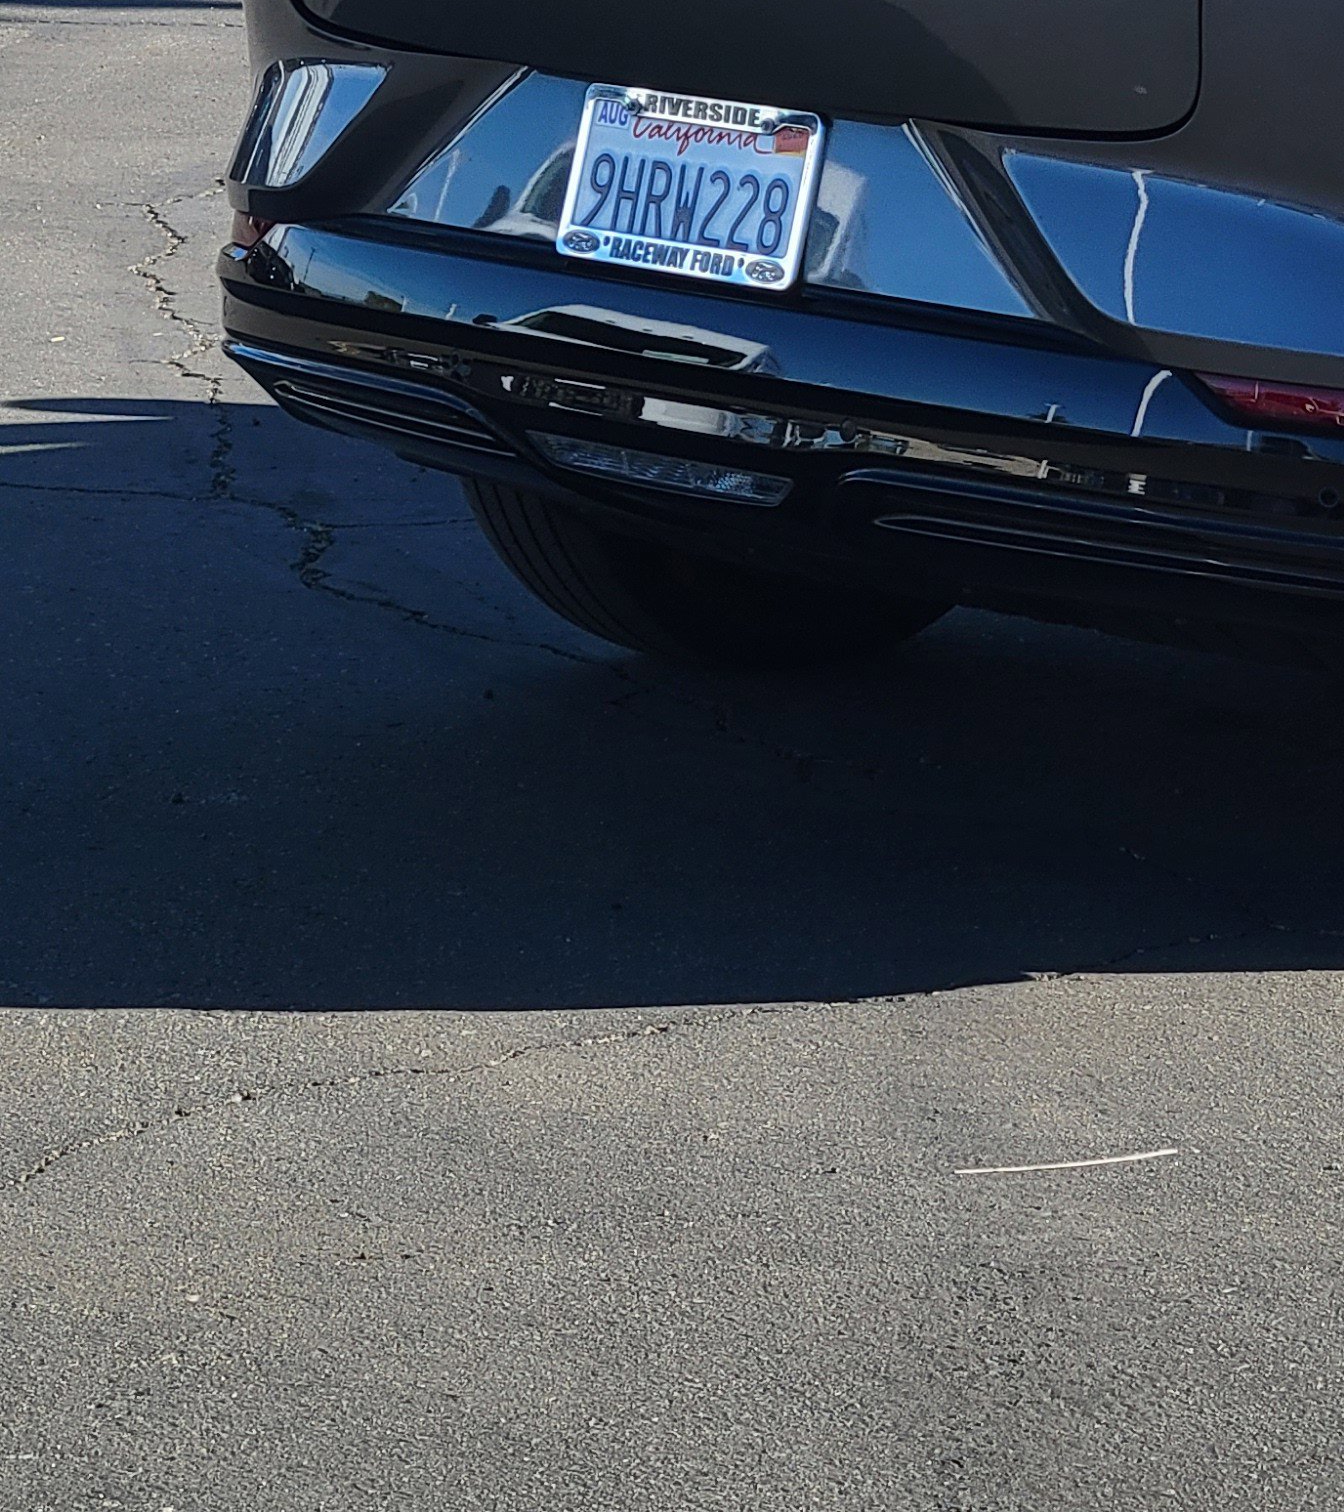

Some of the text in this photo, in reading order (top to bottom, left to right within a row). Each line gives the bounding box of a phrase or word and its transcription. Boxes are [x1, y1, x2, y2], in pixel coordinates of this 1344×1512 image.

[598, 101, 629, 126] AUG
[643, 93, 761, 127] RIVERSIDE
[632, 116, 774, 156] California
[580, 152, 790, 256] 9HRW228
[609, 236, 691, 271] RACEWAY
[691, 249, 734, 276] FORD
